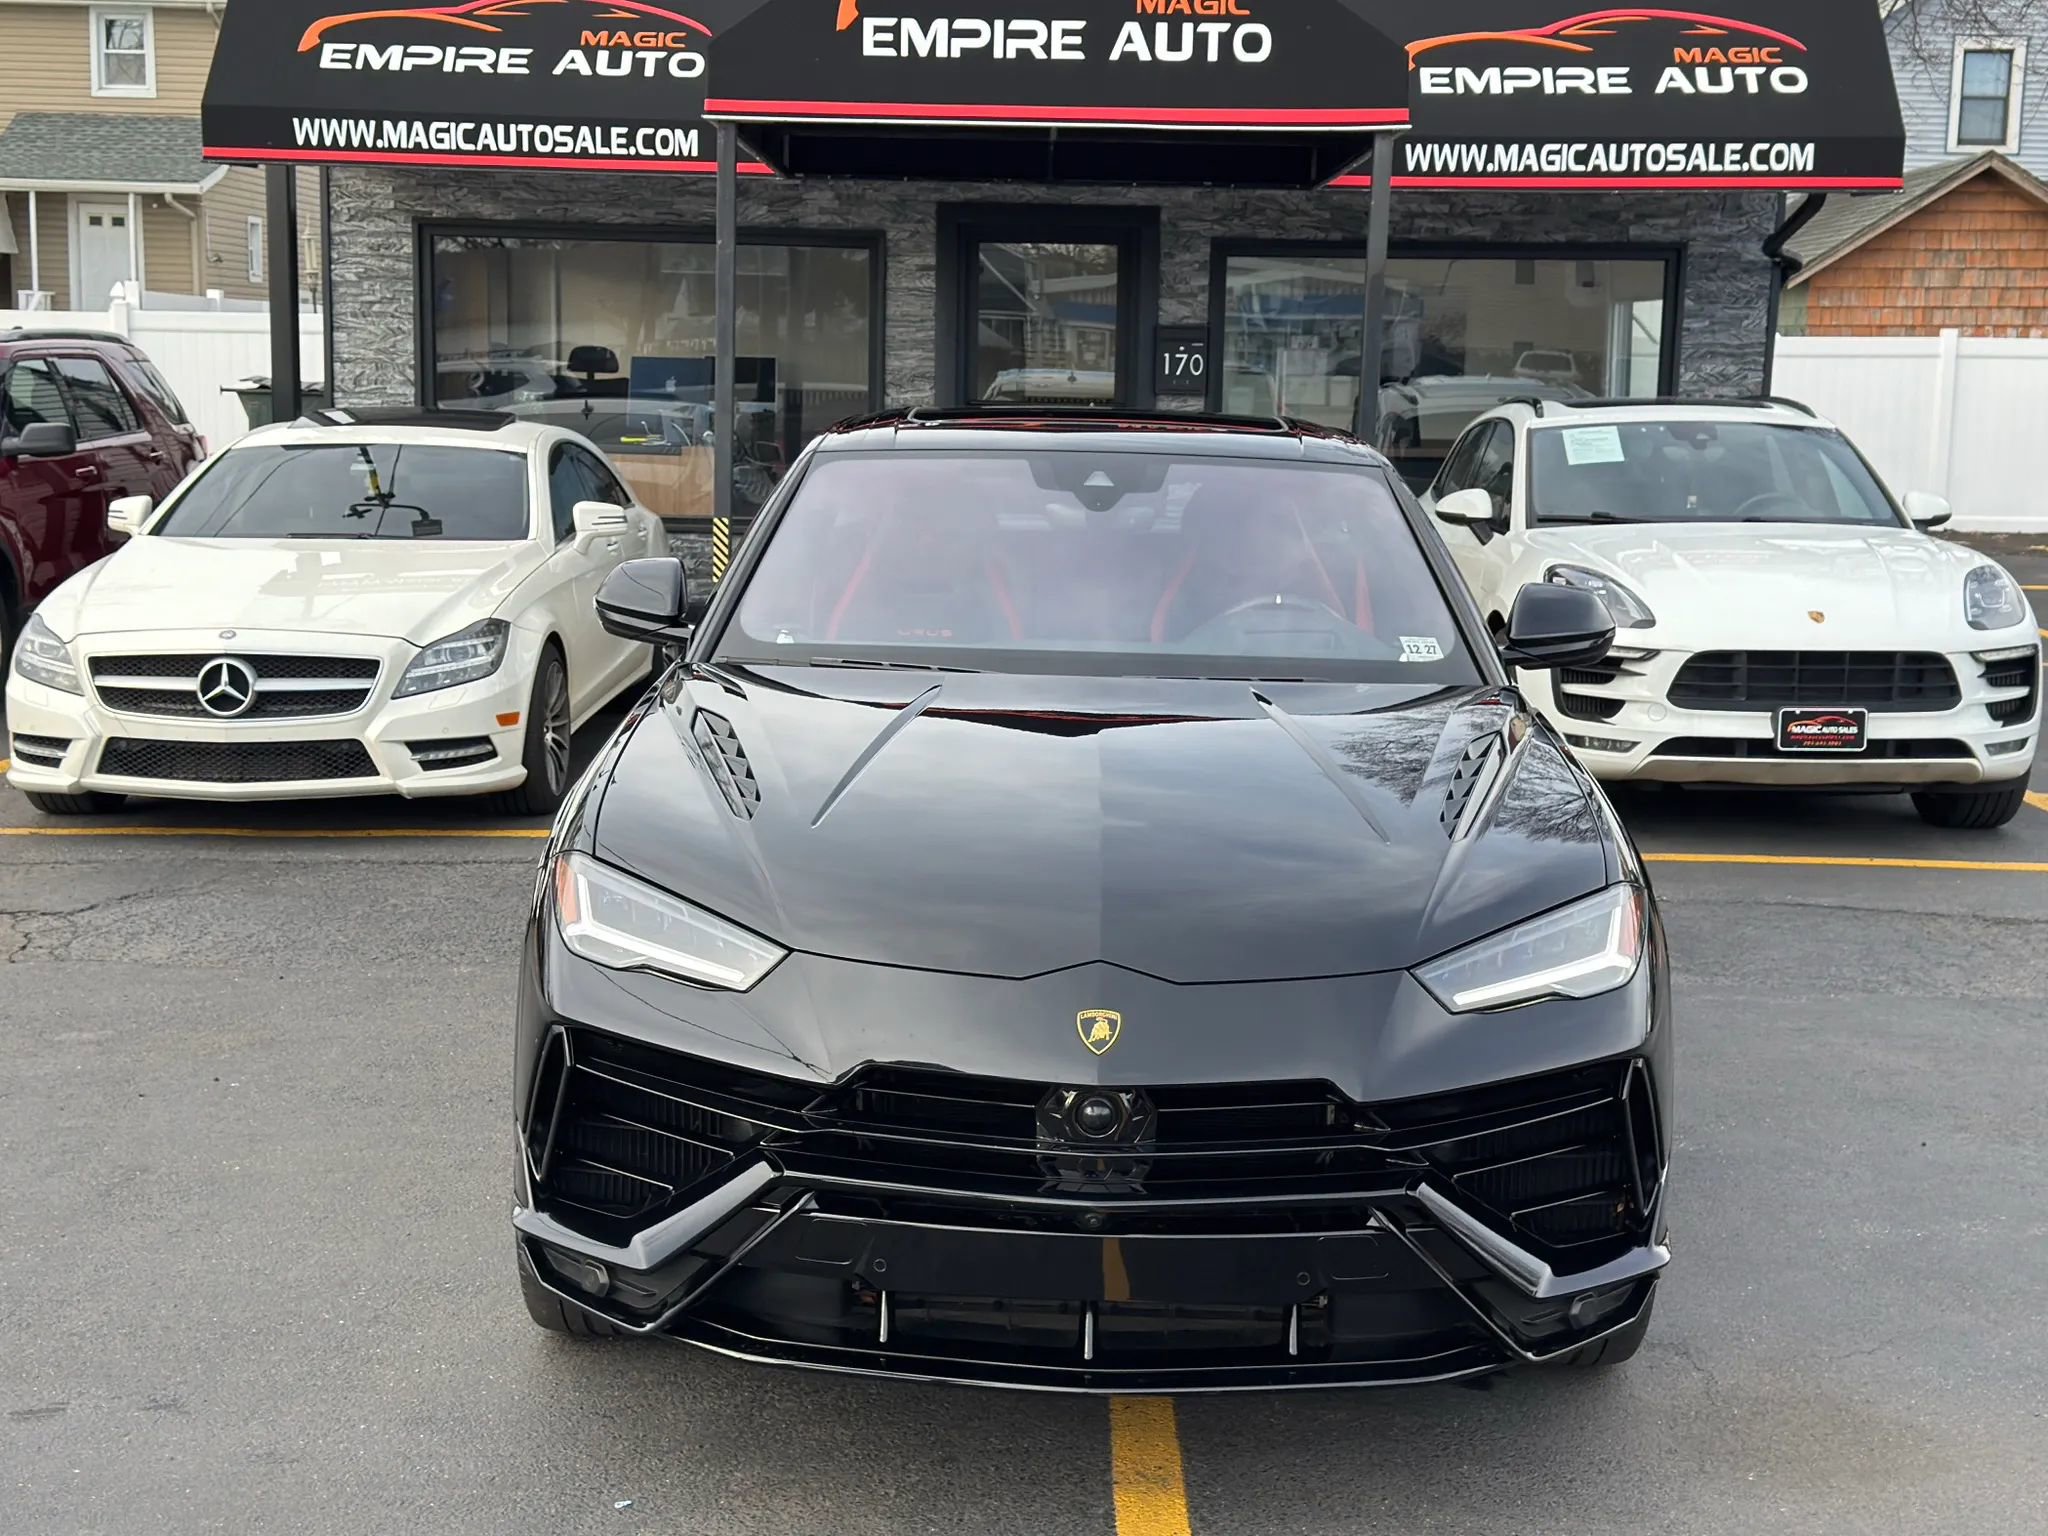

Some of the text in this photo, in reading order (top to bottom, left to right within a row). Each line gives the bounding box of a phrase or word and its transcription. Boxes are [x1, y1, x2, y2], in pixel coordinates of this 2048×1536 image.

[1136, 0, 1251, 16] MAGIC
[580, 30, 688, 49] MAGIC
[862, 17, 1273, 63] EMPIRE AUTO
[319, 42, 706, 79] EMPIRE AUTO
[1674, 47, 1784, 64] MAGIC
[1420, 66, 1809, 95] EMPIRE AUTO
[292, 117, 700, 157] WWW.MAGICAUTOSALE.COM
[1405, 142, 1816, 173] WWW.MAGICAUTOSALE.COM
[1163, 352, 1204, 376] 170
[1406, 644, 1437, 655] 12 27
